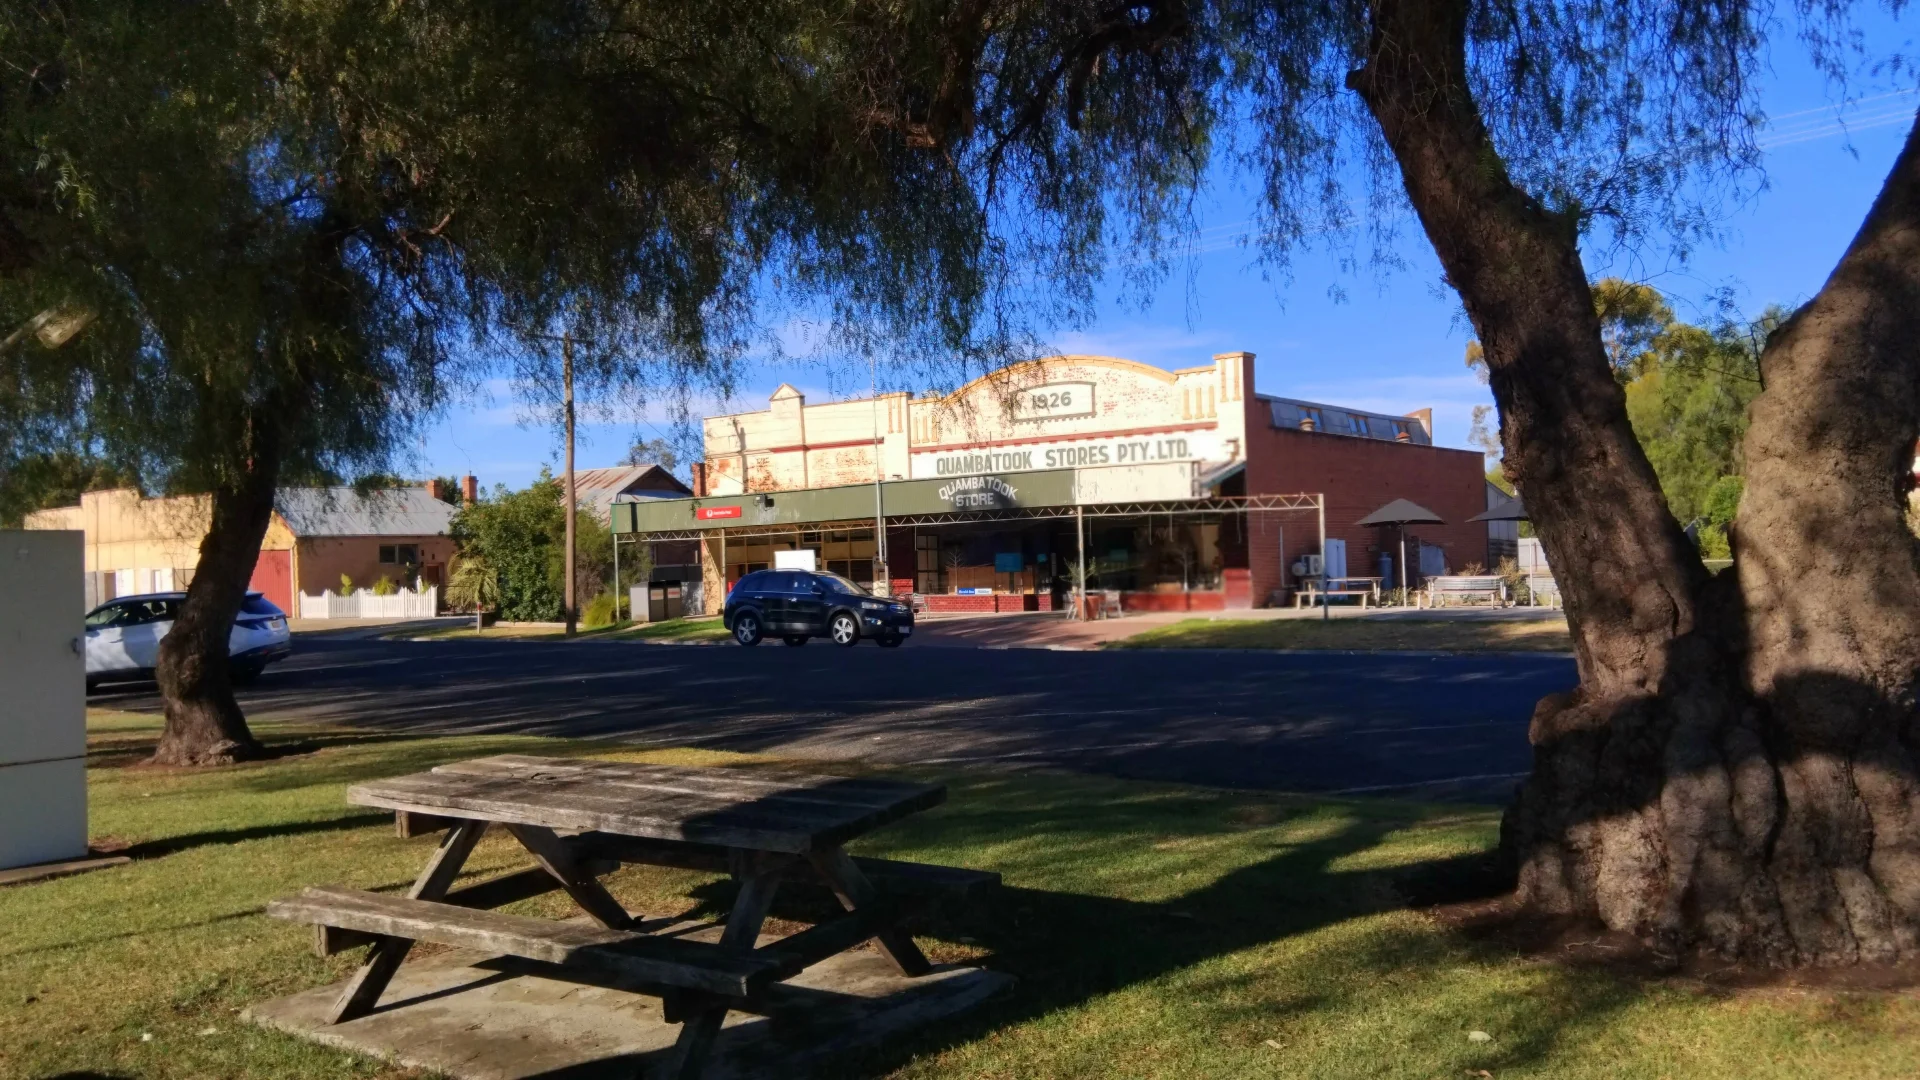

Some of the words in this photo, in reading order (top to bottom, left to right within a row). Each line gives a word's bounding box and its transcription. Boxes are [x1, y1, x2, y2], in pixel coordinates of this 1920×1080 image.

[1032, 391, 1072, 410] 1926
[936, 451, 1032, 475] QUAMBATOOK
[1045, 444, 1110, 467] STORES
[938, 476, 1019, 501] QUAMBATOOK
[955, 492, 995, 507] STORE
